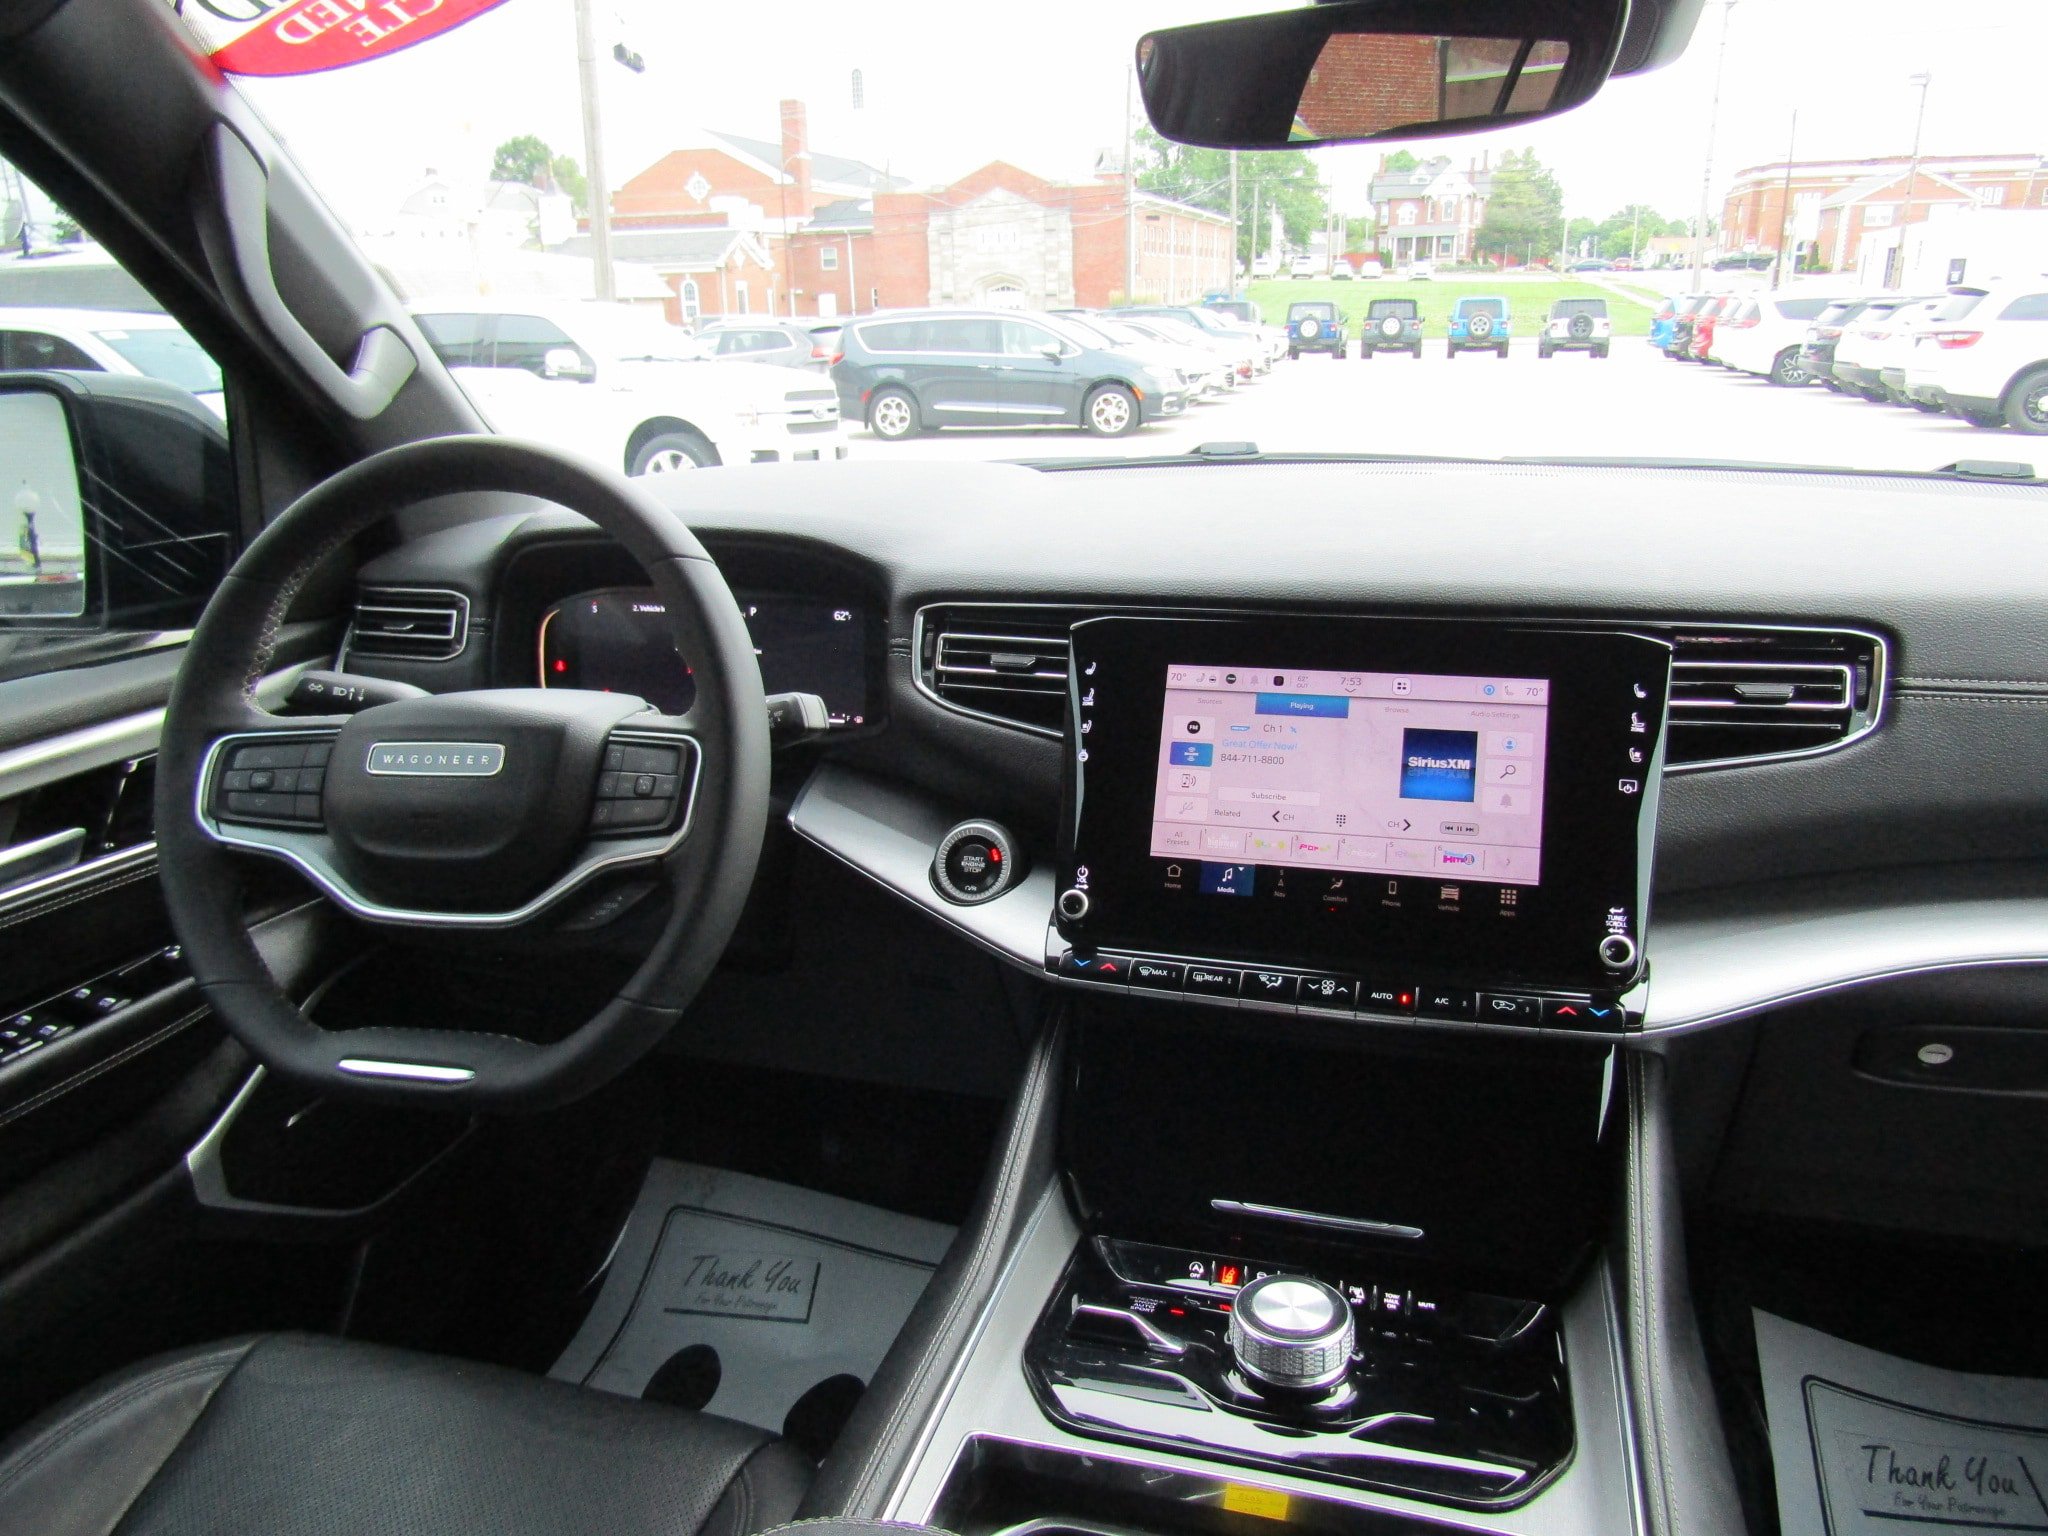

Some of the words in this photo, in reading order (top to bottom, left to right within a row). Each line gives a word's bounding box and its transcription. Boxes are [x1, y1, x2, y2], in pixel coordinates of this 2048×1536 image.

[750, 607, 757, 616] P
[1171, 673, 1187, 682] 70°
[1340, 677, 1362, 686] 7:53
[1526, 687, 1544, 697] 70°
[1290, 702, 1314, 710] Playing
[1263, 724, 1276, 733] Ch
[1222, 739, 1246, 748] Great
[1249, 740, 1272, 749] Offer
[1274, 741, 1298, 750] Now!
[383, 754, 490, 765] WAGONEER
[1220, 753, 1285, 765] 844-711-8800
[1408, 756, 1471, 770] SiriusXM
[1251, 791, 1287, 801] Subscribe
[1214, 809, 1241, 818] Related
[1323, 894, 1348, 902] Comfort
[1382, 899, 1401, 907] Phone
[1500, 909, 1515, 917] Apps
[1605, 920, 1628, 928] SCROLL
[1151, 969, 1168, 977] MAX
[1205, 973, 1223, 982] REAR
[1371, 992, 1393, 1000] AUTO
[1434, 997, 1449, 1005] A/C
[684, 1253, 763, 1291] Thank
[765, 1260, 802, 1294] You
[1417, 1301, 1436, 1309] MUTE
[1861, 1445, 1956, 1491] Thank
[1965, 1456, 2019, 1496] You
